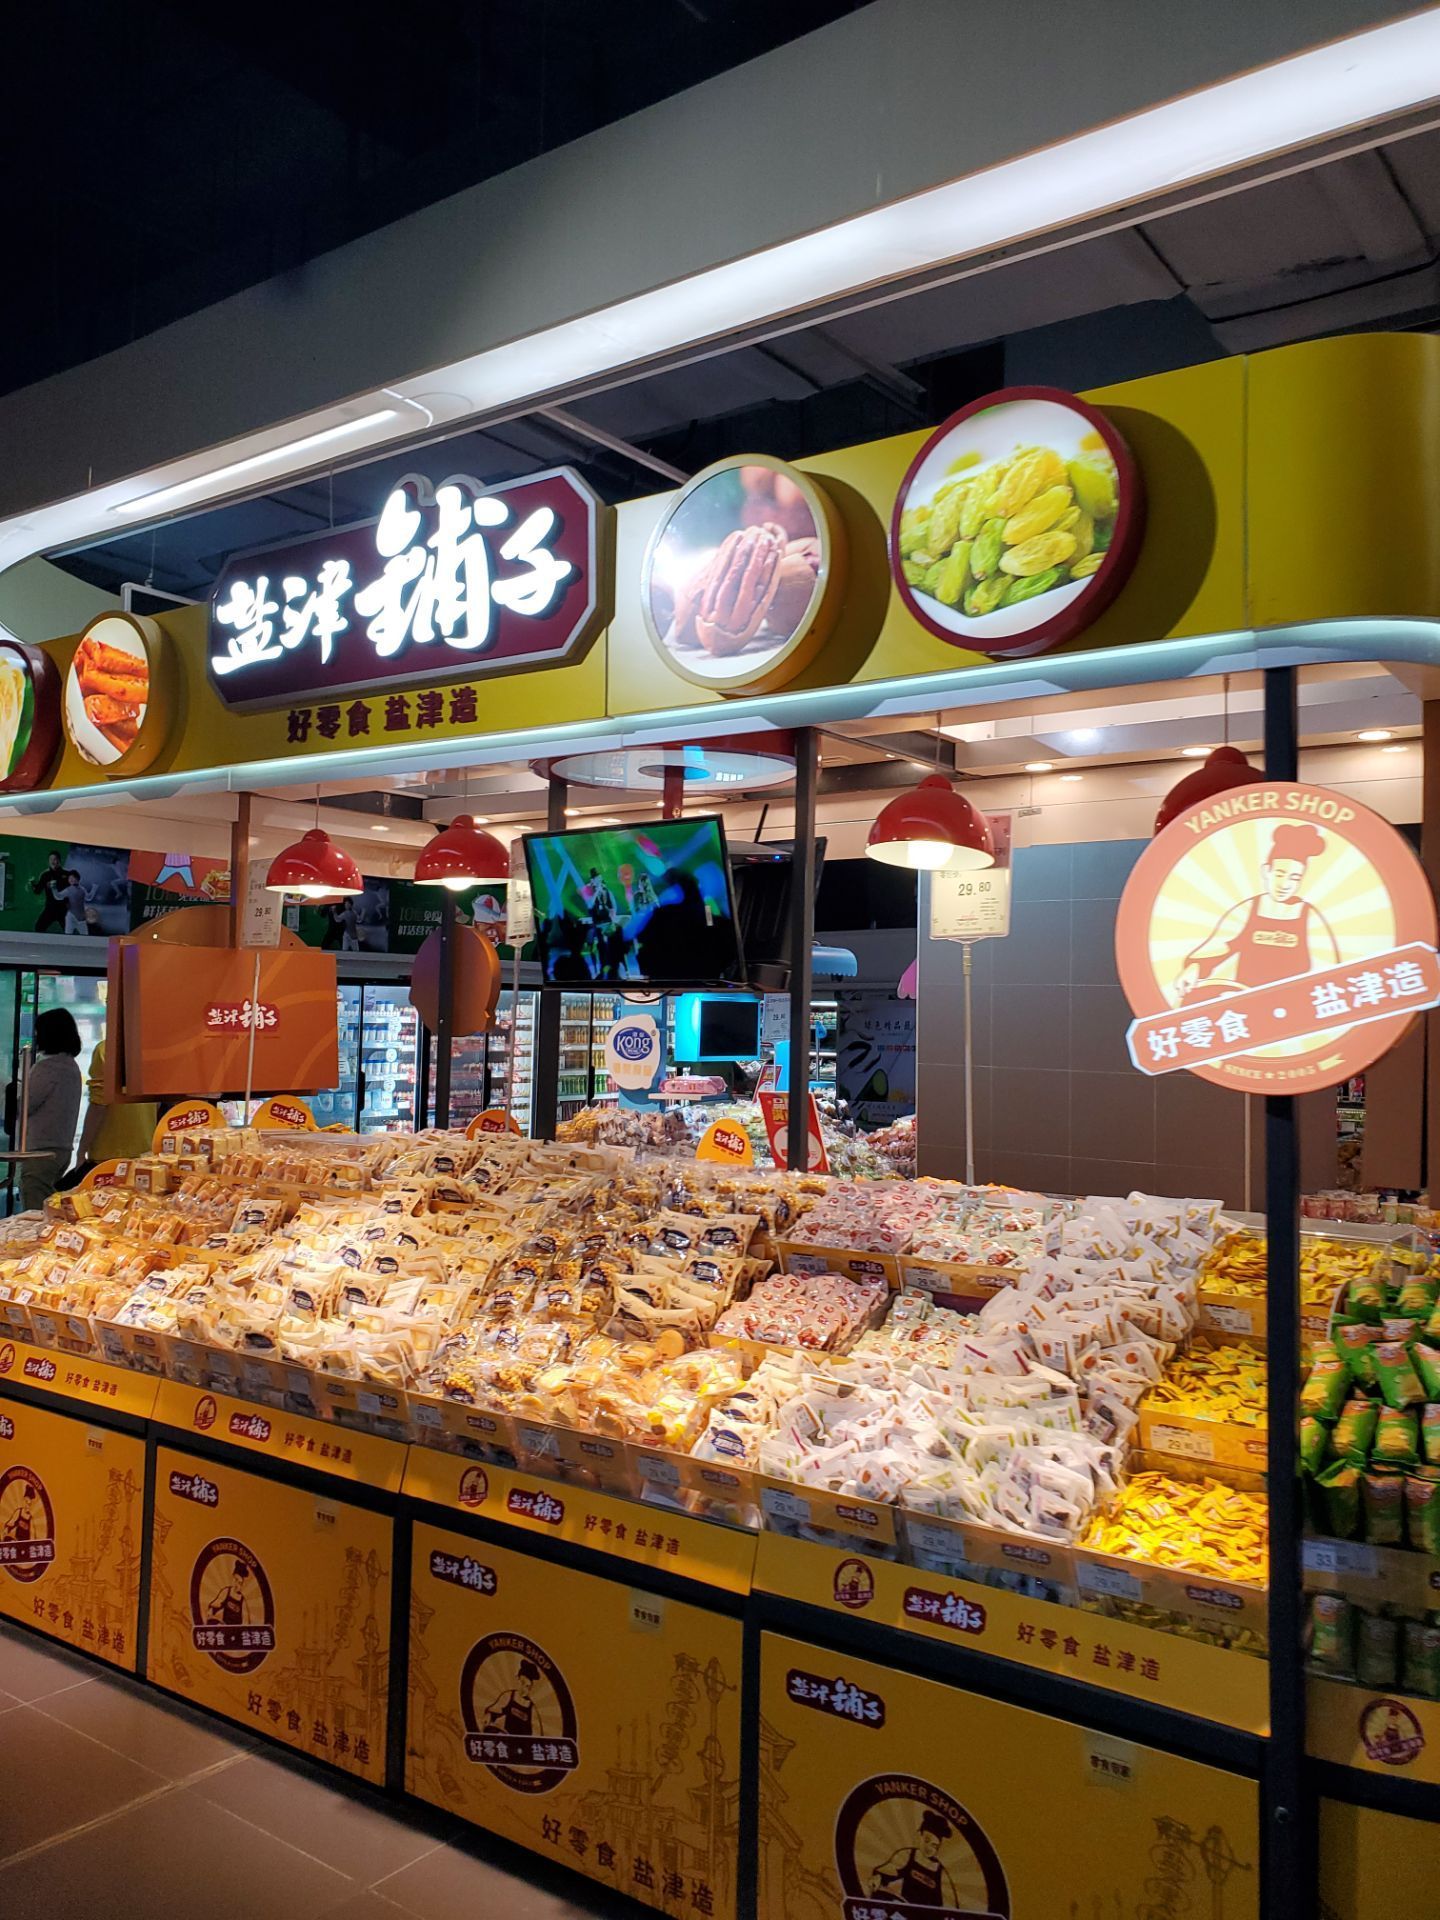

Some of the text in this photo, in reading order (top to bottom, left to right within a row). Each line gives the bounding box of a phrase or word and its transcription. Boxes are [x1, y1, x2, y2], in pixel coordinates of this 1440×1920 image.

[212, 486, 572, 675] 盐津铺子
[287, 686, 478, 743] 好零食 盐津造
[1184, 791, 1356, 834] YANKER SHOP
[207, 1001, 277, 1029] 盐津铺子
[1147, 961, 1428, 1061] 好零食 盐津造
[284, 1432, 353, 1464] 好零食 盐津造
[509, 1492, 562, 1523] 盐津铺子
[583, 1514, 681, 1556] 好零食 盐津造
[432, 1557, 494, 1590] 盐津铺子
[33, 1596, 125, 1654] 好零食 盐津造
[905, 1591, 983, 1630] 盐津铺子
[196, 1631, 272, 1646] 好零食 盐津造
[488, 1638, 551, 1670] YANKER SHOP
[1017, 1622, 1160, 1681] 好零食 盐津造
[791, 1677, 883, 1723] 盐津铺子
[247, 1690, 370, 1764] 好零食 盐津造
[470, 1740, 573, 1763] 好零食 盐津造
[875, 1781, 968, 1826] YANKER SHOP
[542, 1814, 715, 1917] 好零食 盐津造
